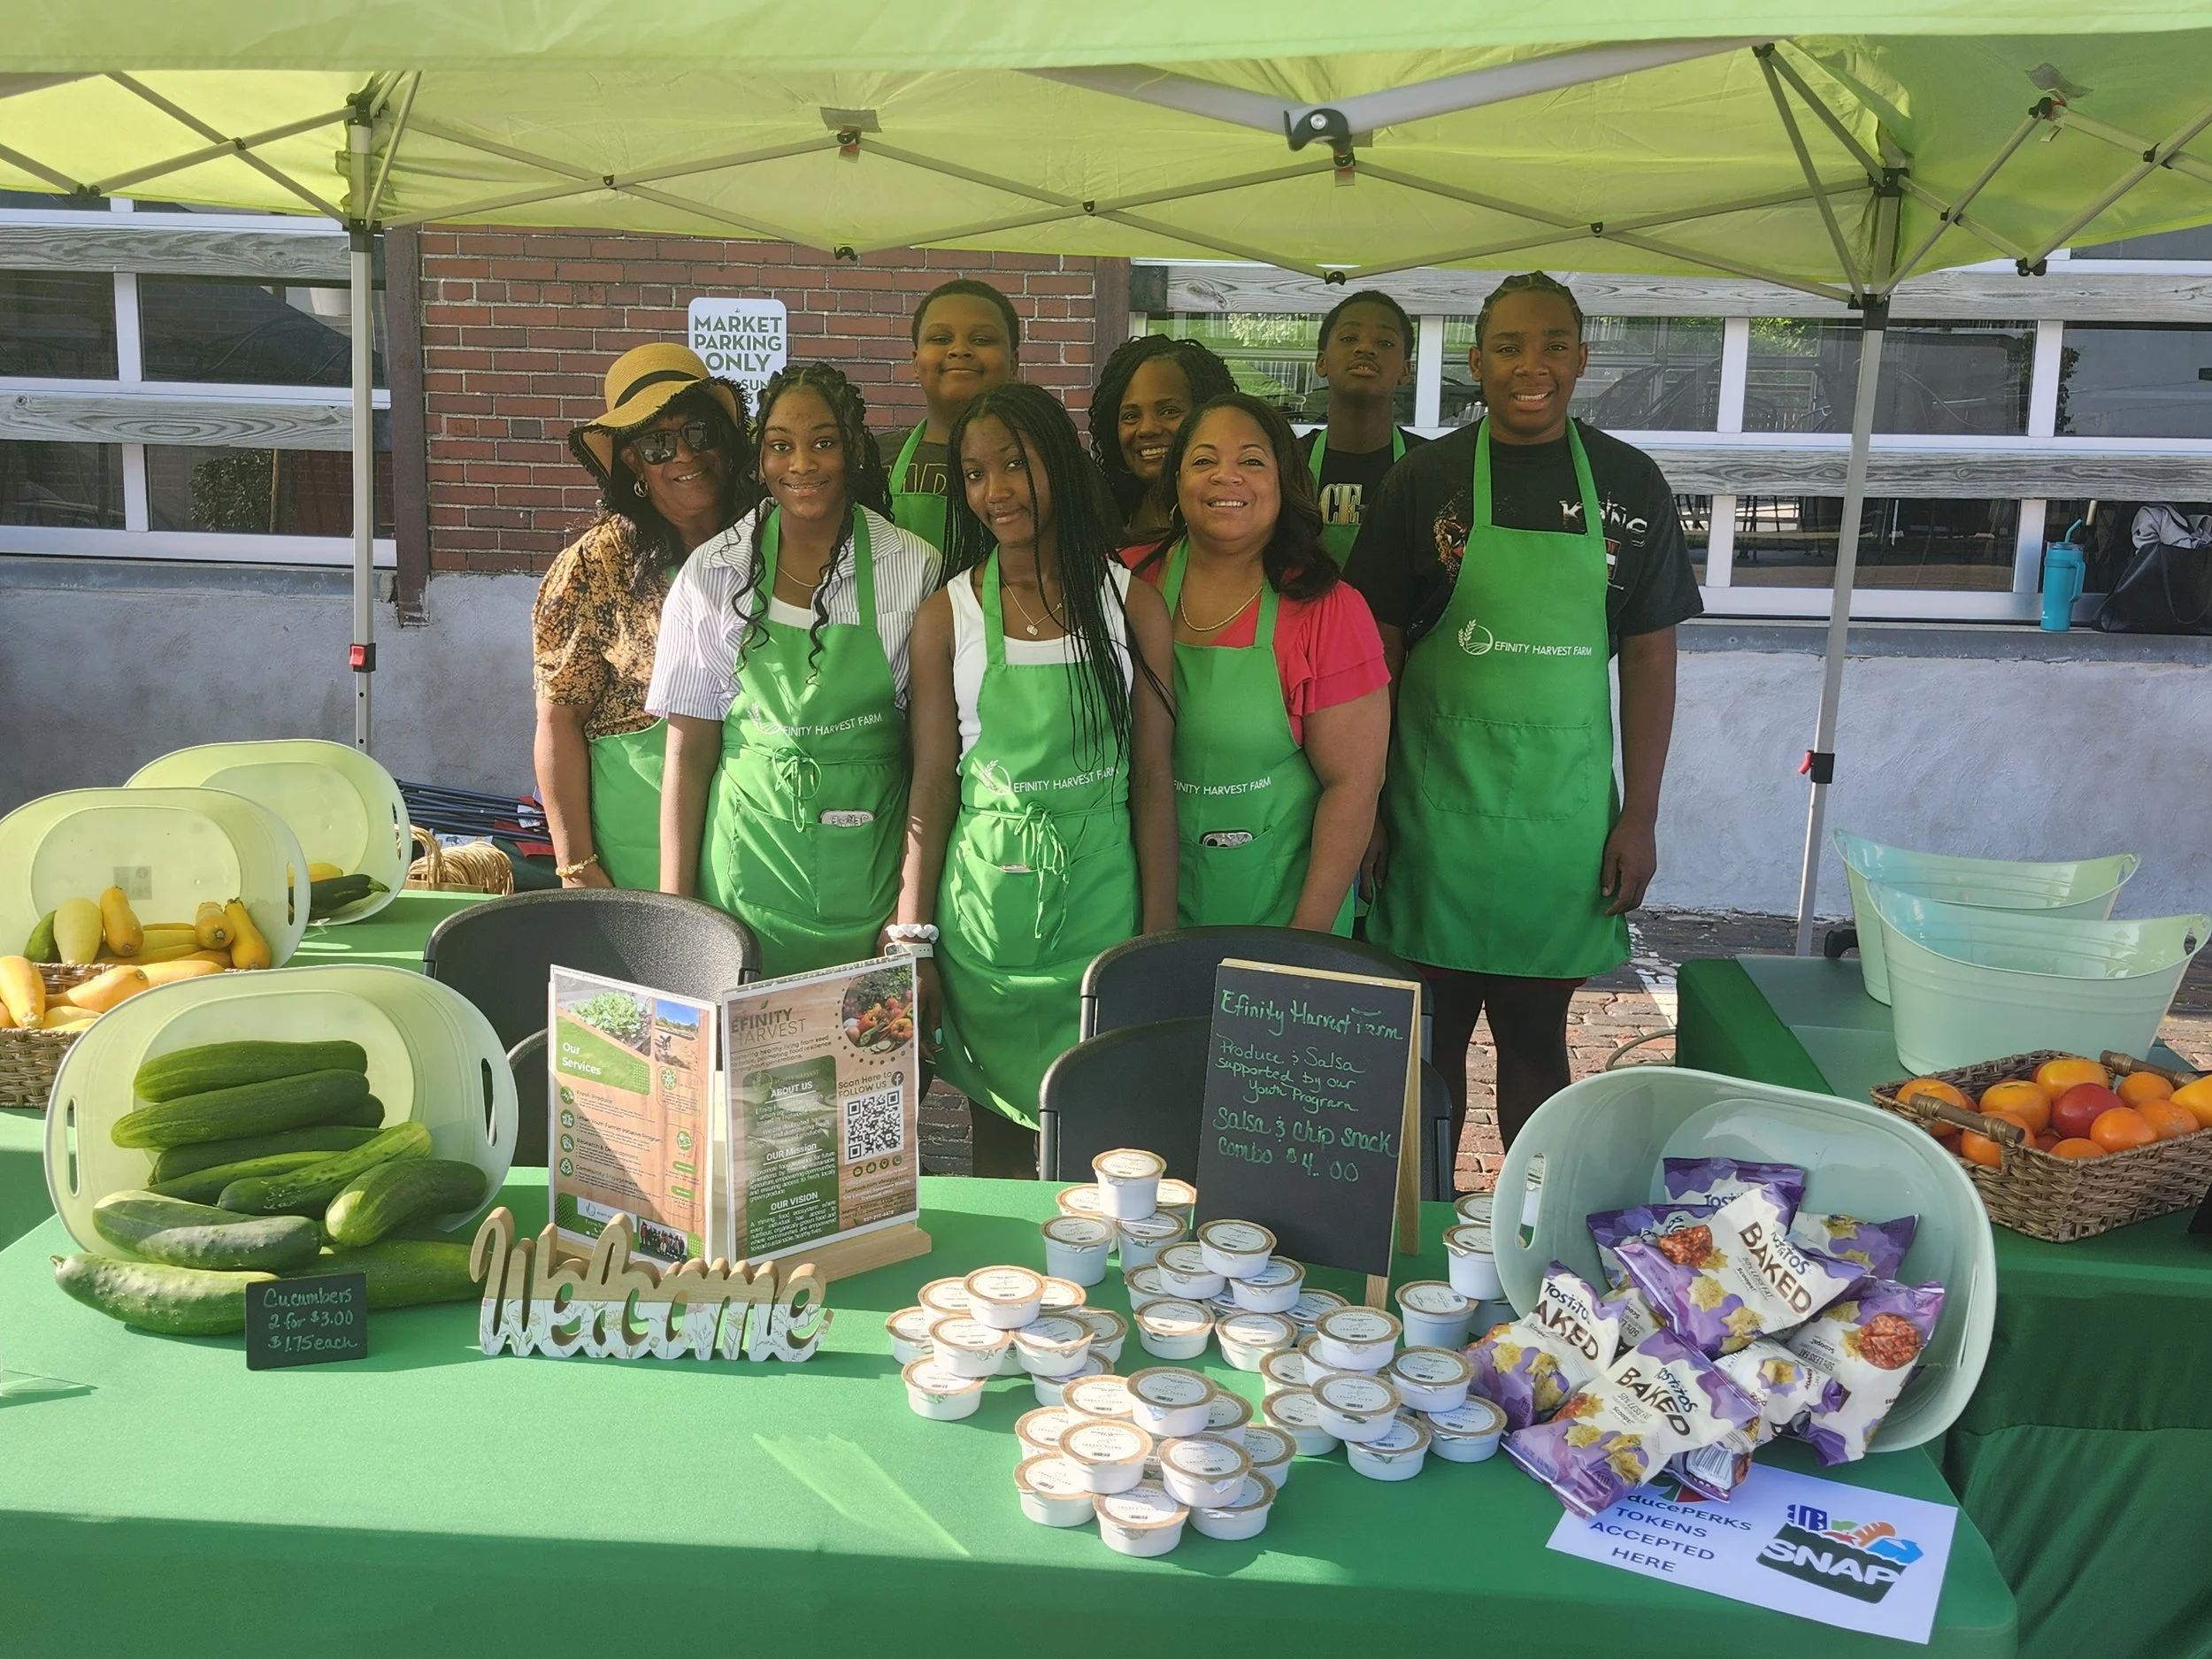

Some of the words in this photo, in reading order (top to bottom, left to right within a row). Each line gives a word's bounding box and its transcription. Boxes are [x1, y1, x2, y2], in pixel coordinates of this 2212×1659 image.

[694, 315, 782, 334] MARKET
[695, 334, 782, 351] PARKING
[705, 352, 772, 372] ONLY
[1494, 641, 1530, 653] EFINITY
[1532, 645, 1572, 656] HARVEST
[1572, 646, 1592, 656] FARM
[815, 718, 856, 735] HARVEST
[857, 712, 883, 726] FARM
[1013, 780, 1049, 793] EFINITY
[1053, 772, 1094, 789] HARVEST
[1203, 783, 1248, 795] HARVEST
[1249, 776, 1271, 791] FARM
[731, 1007, 793, 1033] EFINITY
[1290, 1000, 1351, 1034] Harvest
[730, 1018, 806, 1046] HARVEST
[563, 1041, 580, 1056] Our
[1216, 1032, 1285, 1064] Produce
[1303, 1047, 1366, 1074] Salsa
[562, 1056, 603, 1076] Services
[770, 1083, 800, 1098] ABOUT
[801, 1080, 813, 1090] US
[838, 1079, 859, 1089] Scan
[861, 1074, 881, 1084] Here
[839, 1083, 873, 1097] FOLLOW
[876, 1080, 887, 1089] US
[1302, 1071, 1322, 1094] by
[1326, 1078, 1356, 1089] our
[1285, 1083, 1359, 1114] Program
[1212, 1106, 1271, 1134] Salsa
[576, 1138, 600, 1149] Research
[766, 1150, 785, 1161] OUR
[786, 1143, 818, 1156] Mission
[771, 1200, 788, 1211] OUR
[789, 1191, 818, 1206] VISION
[1738, 1221, 1812, 1315] BAKED
[469, 1206, 834, 1363] Welcome
[263, 1287, 352, 1309] Cucumbers
[268, 1313, 280, 1330] 2
[283, 1312, 306, 1330] for
[311, 1310, 354, 1326] $3.00
[1615, 1366, 1691, 1436] BAKED
[1615, 1506, 1708, 1539] TOKENS
[1589, 1522, 1716, 1561] ACCEPTED
[1611, 1547, 1678, 1572] HERE
[1761, 1538, 1903, 1586] SNAP
